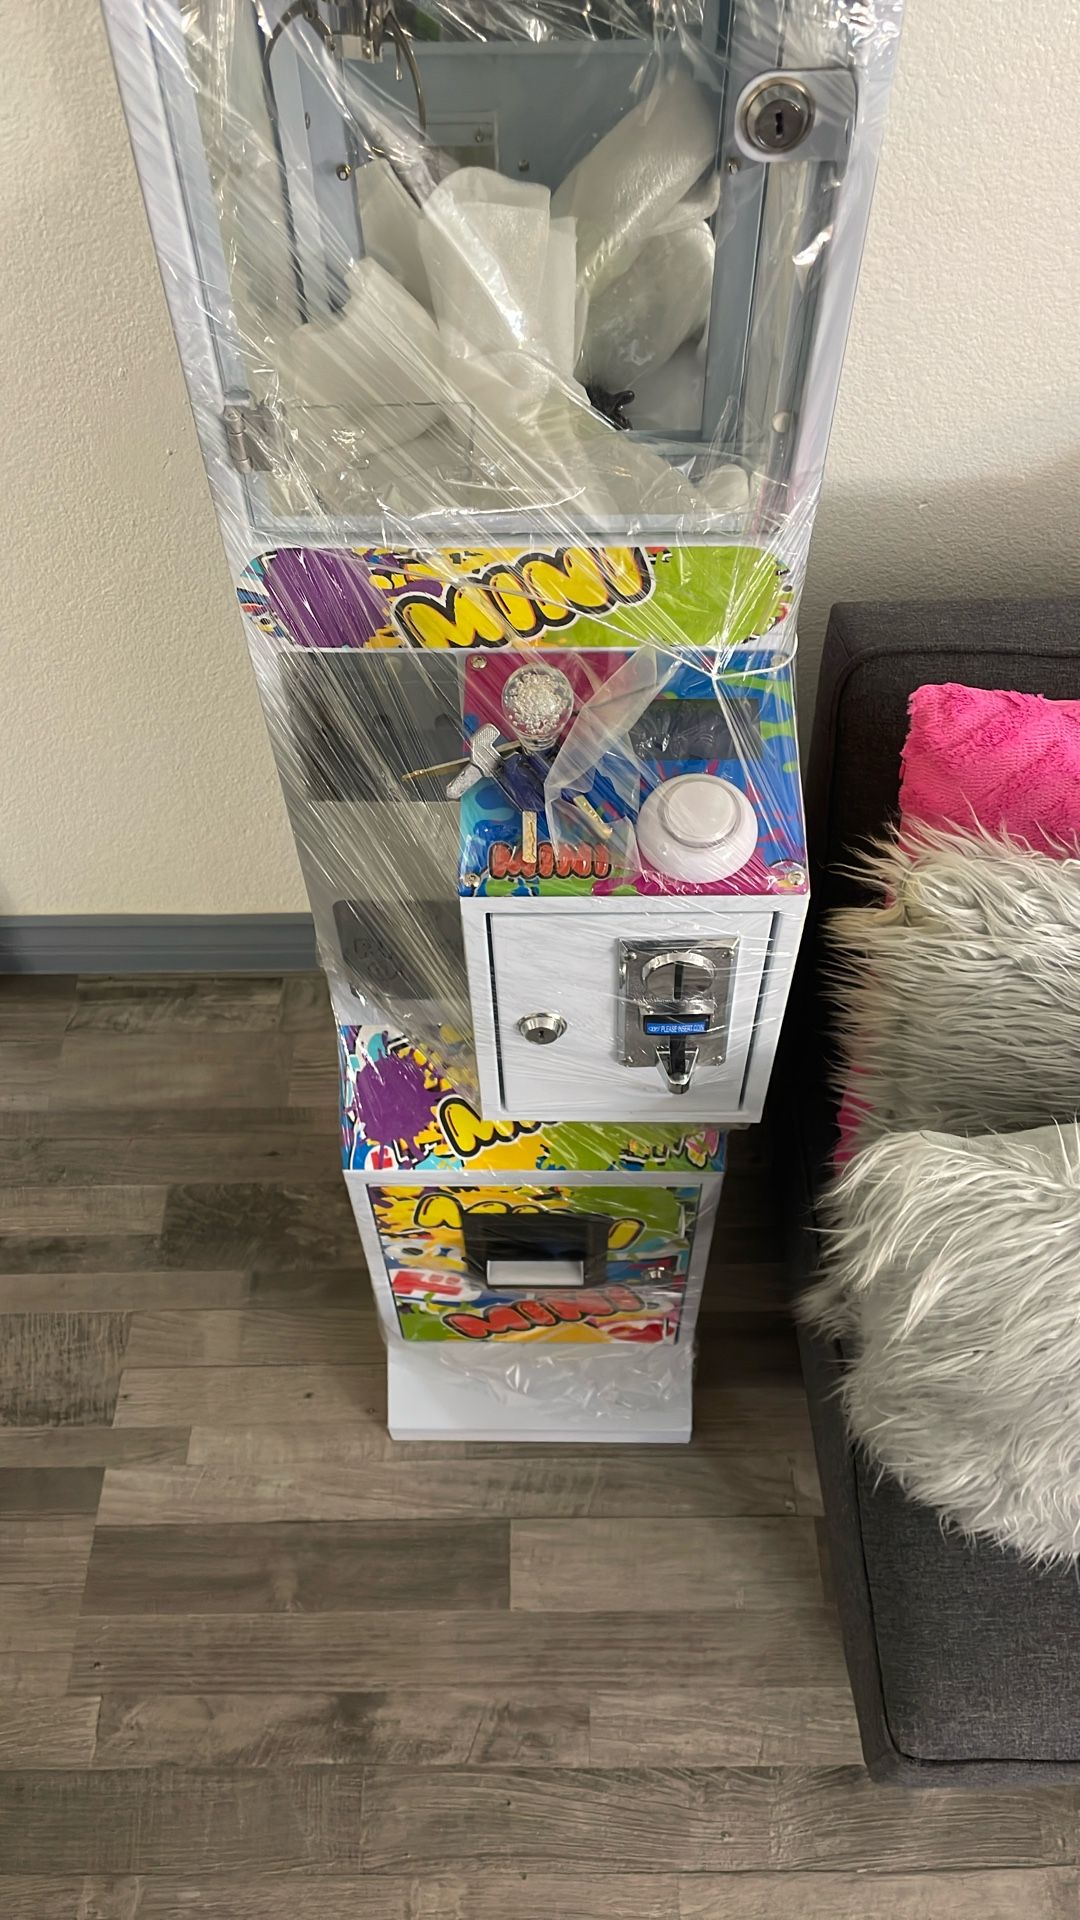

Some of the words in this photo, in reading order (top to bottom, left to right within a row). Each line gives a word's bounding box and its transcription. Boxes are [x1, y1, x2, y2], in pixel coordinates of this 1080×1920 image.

[393, 547, 653, 648] MINI
[660, 1025, 677, 1033] PLEASE
[677, 1024, 693, 1033] INSERT
[443, 1283, 645, 1339] MINI
